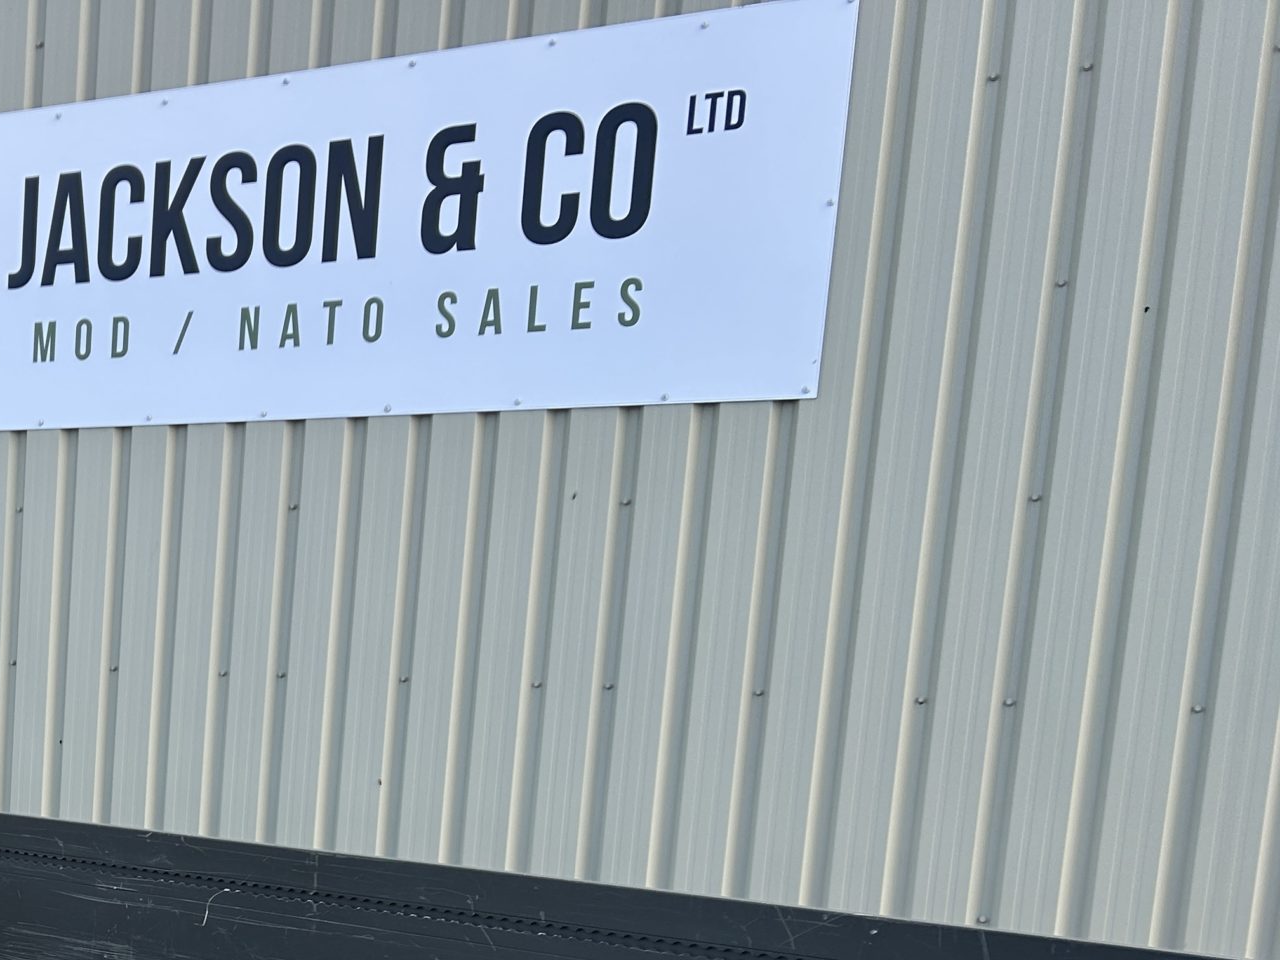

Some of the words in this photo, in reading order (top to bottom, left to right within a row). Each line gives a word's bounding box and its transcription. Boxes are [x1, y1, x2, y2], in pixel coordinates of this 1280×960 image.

[6, 133, 385, 291] JACKSON
[420, 122, 486, 256] &
[520, 101, 659, 246] CO
[685, 89, 748, 137] LTD
[31, 316, 131, 364] MOD
[171, 309, 195, 357] /
[237, 296, 385, 352] NATO
[434, 276, 644, 339] SALES
